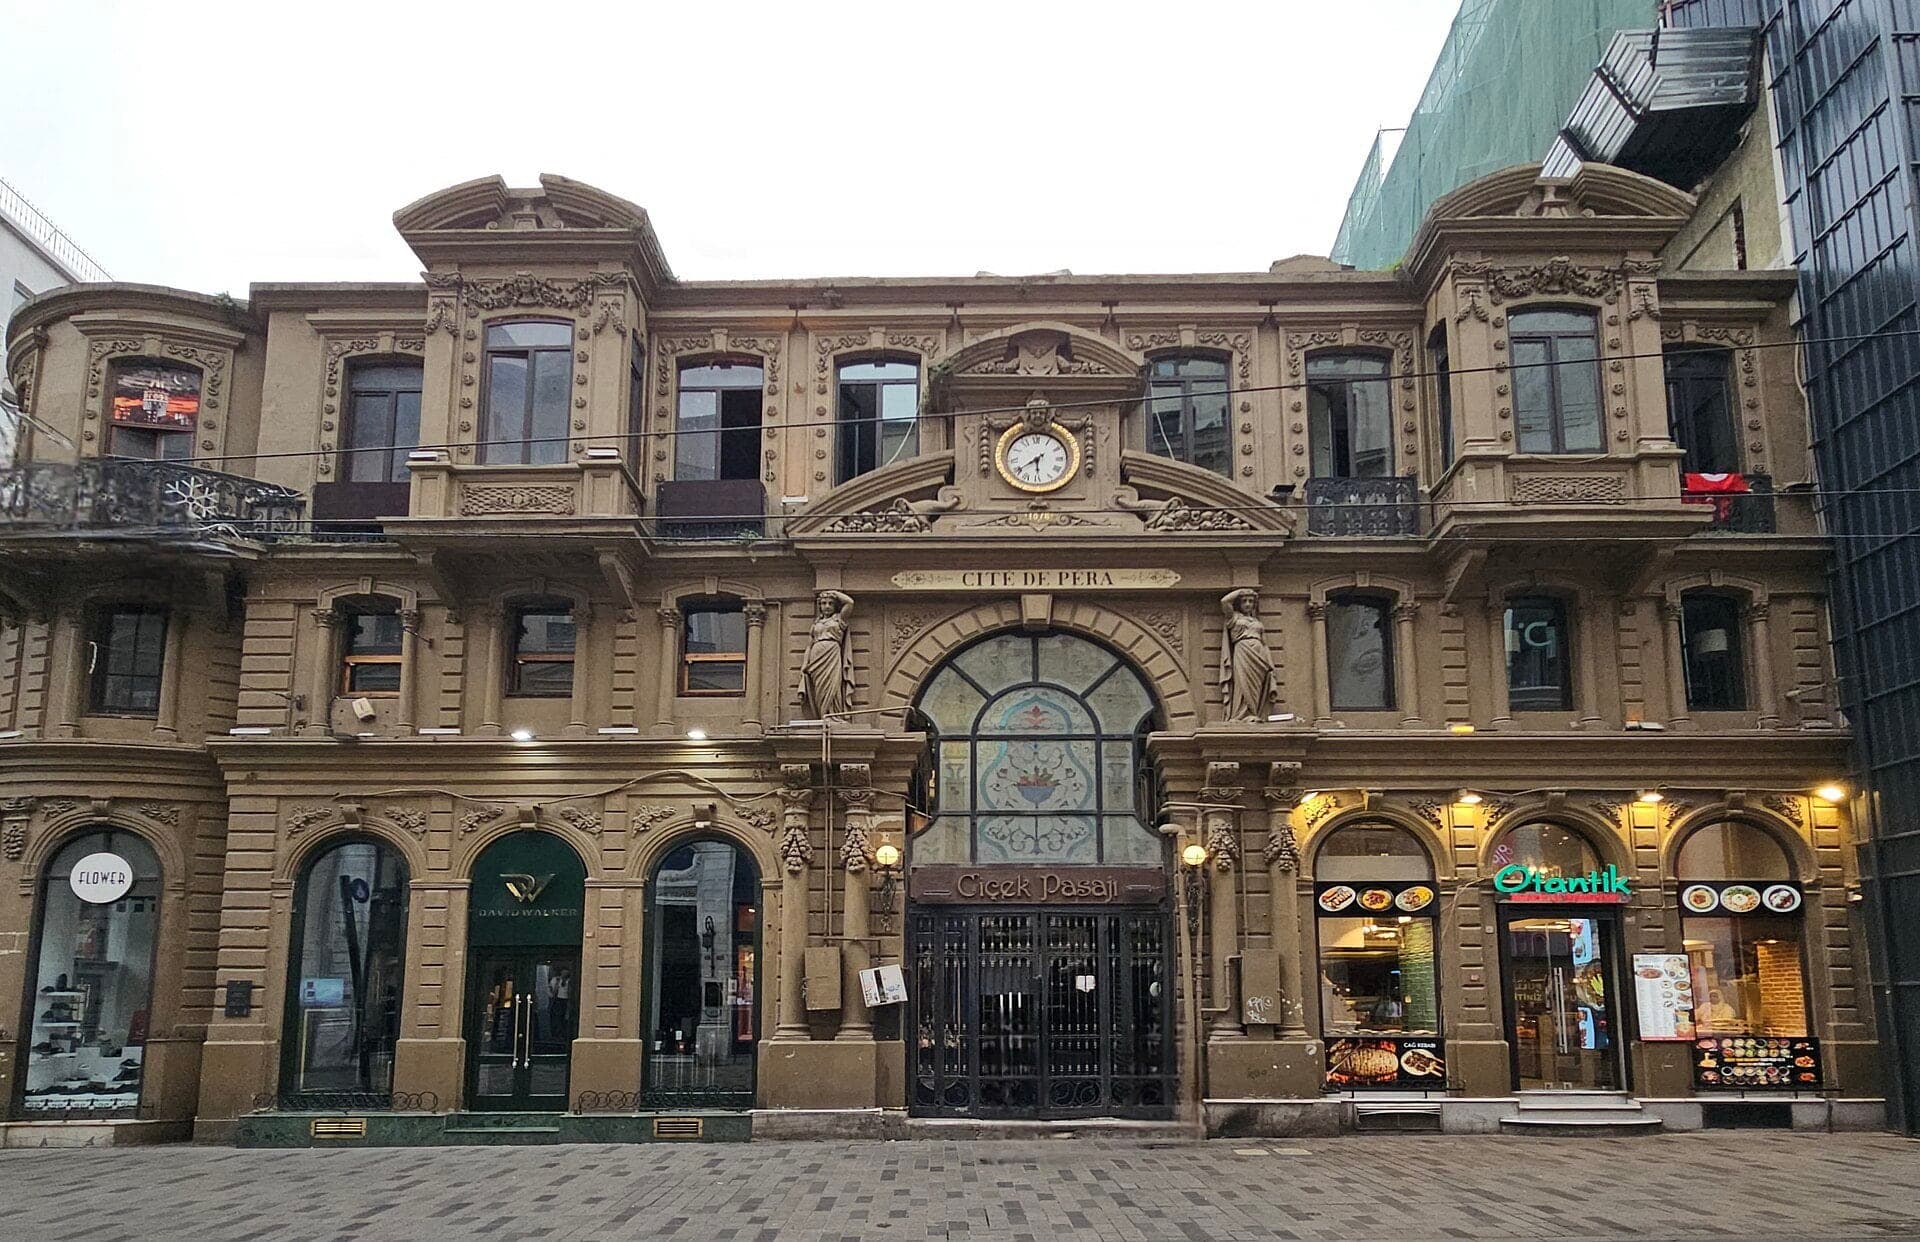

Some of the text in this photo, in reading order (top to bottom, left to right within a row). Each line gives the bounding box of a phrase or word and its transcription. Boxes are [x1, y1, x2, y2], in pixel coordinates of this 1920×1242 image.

[1023, 571, 1050, 586] DE
[79, 871, 125, 884] FLOWER
[1494, 863, 1632, 894] Otantik
